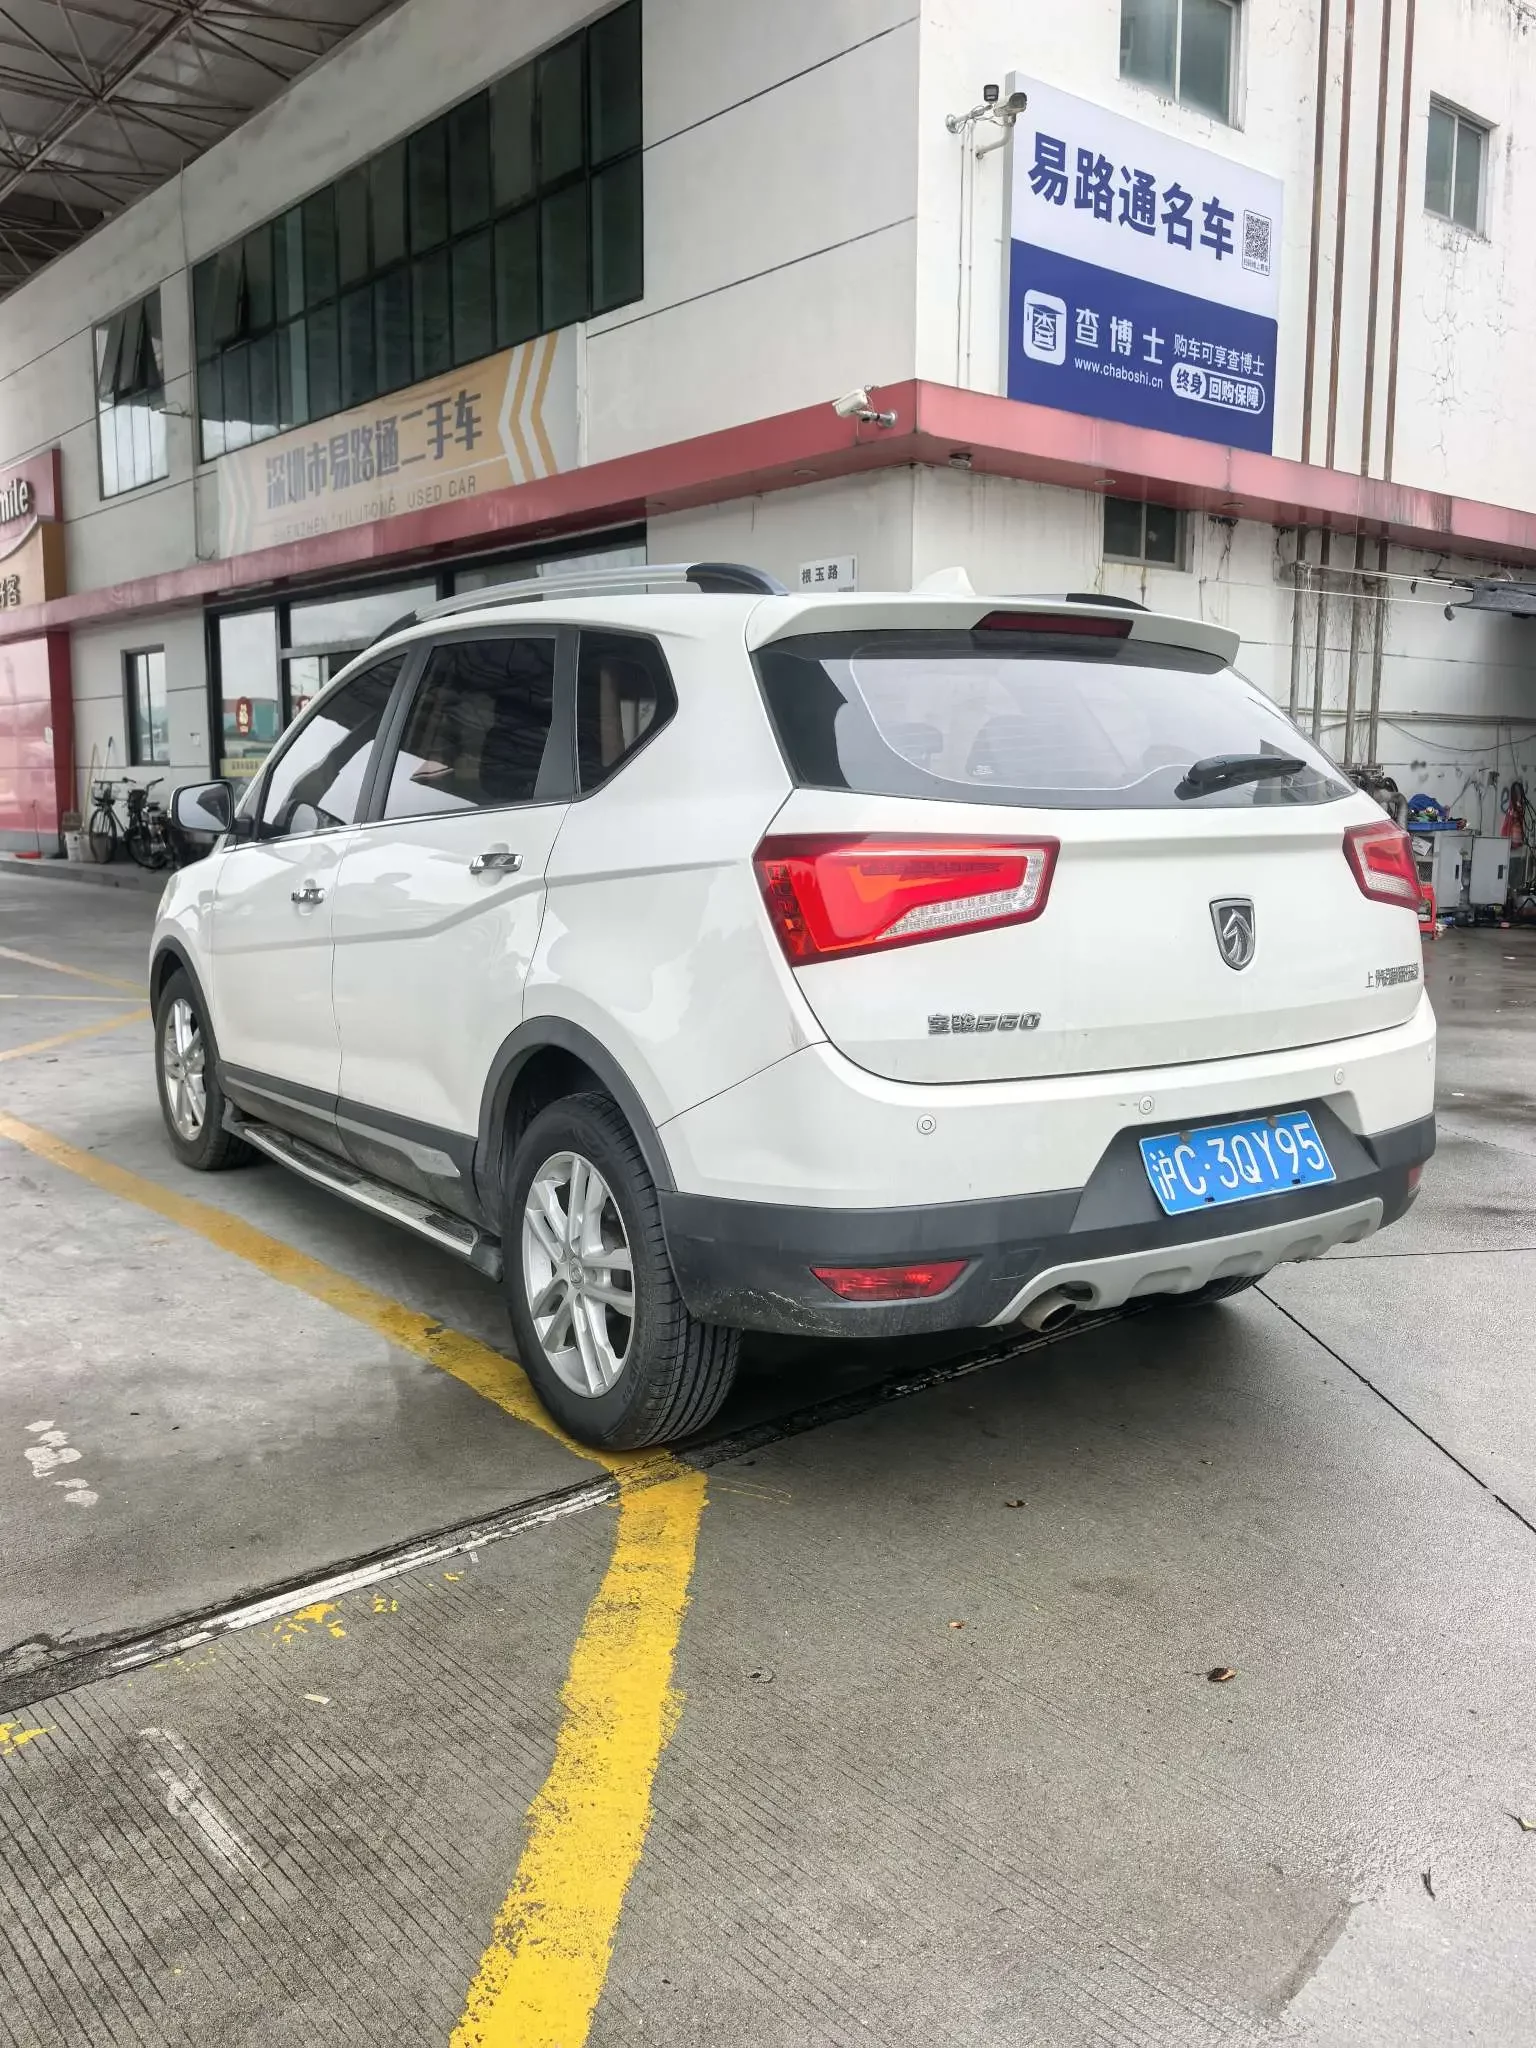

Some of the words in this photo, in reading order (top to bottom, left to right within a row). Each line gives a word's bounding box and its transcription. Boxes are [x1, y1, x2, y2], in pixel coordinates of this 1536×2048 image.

[1027, 131, 1234, 261] 易路通名车
[1075, 308, 1165, 365] 查博士
[1174, 333, 1265, 377] 购车可享查博士
[1074, 357, 1164, 390] www.chaboshi.cn
[1176, 368, 1202, 396] 终身
[1208, 377, 1259, 409] 回购保障
[265, 388, 483, 510] 深圳市易路通二手车
[407, 484, 443, 508] USED
[448, 475, 477, 497] CAR
[801, 564, 838, 584] 根玉路
